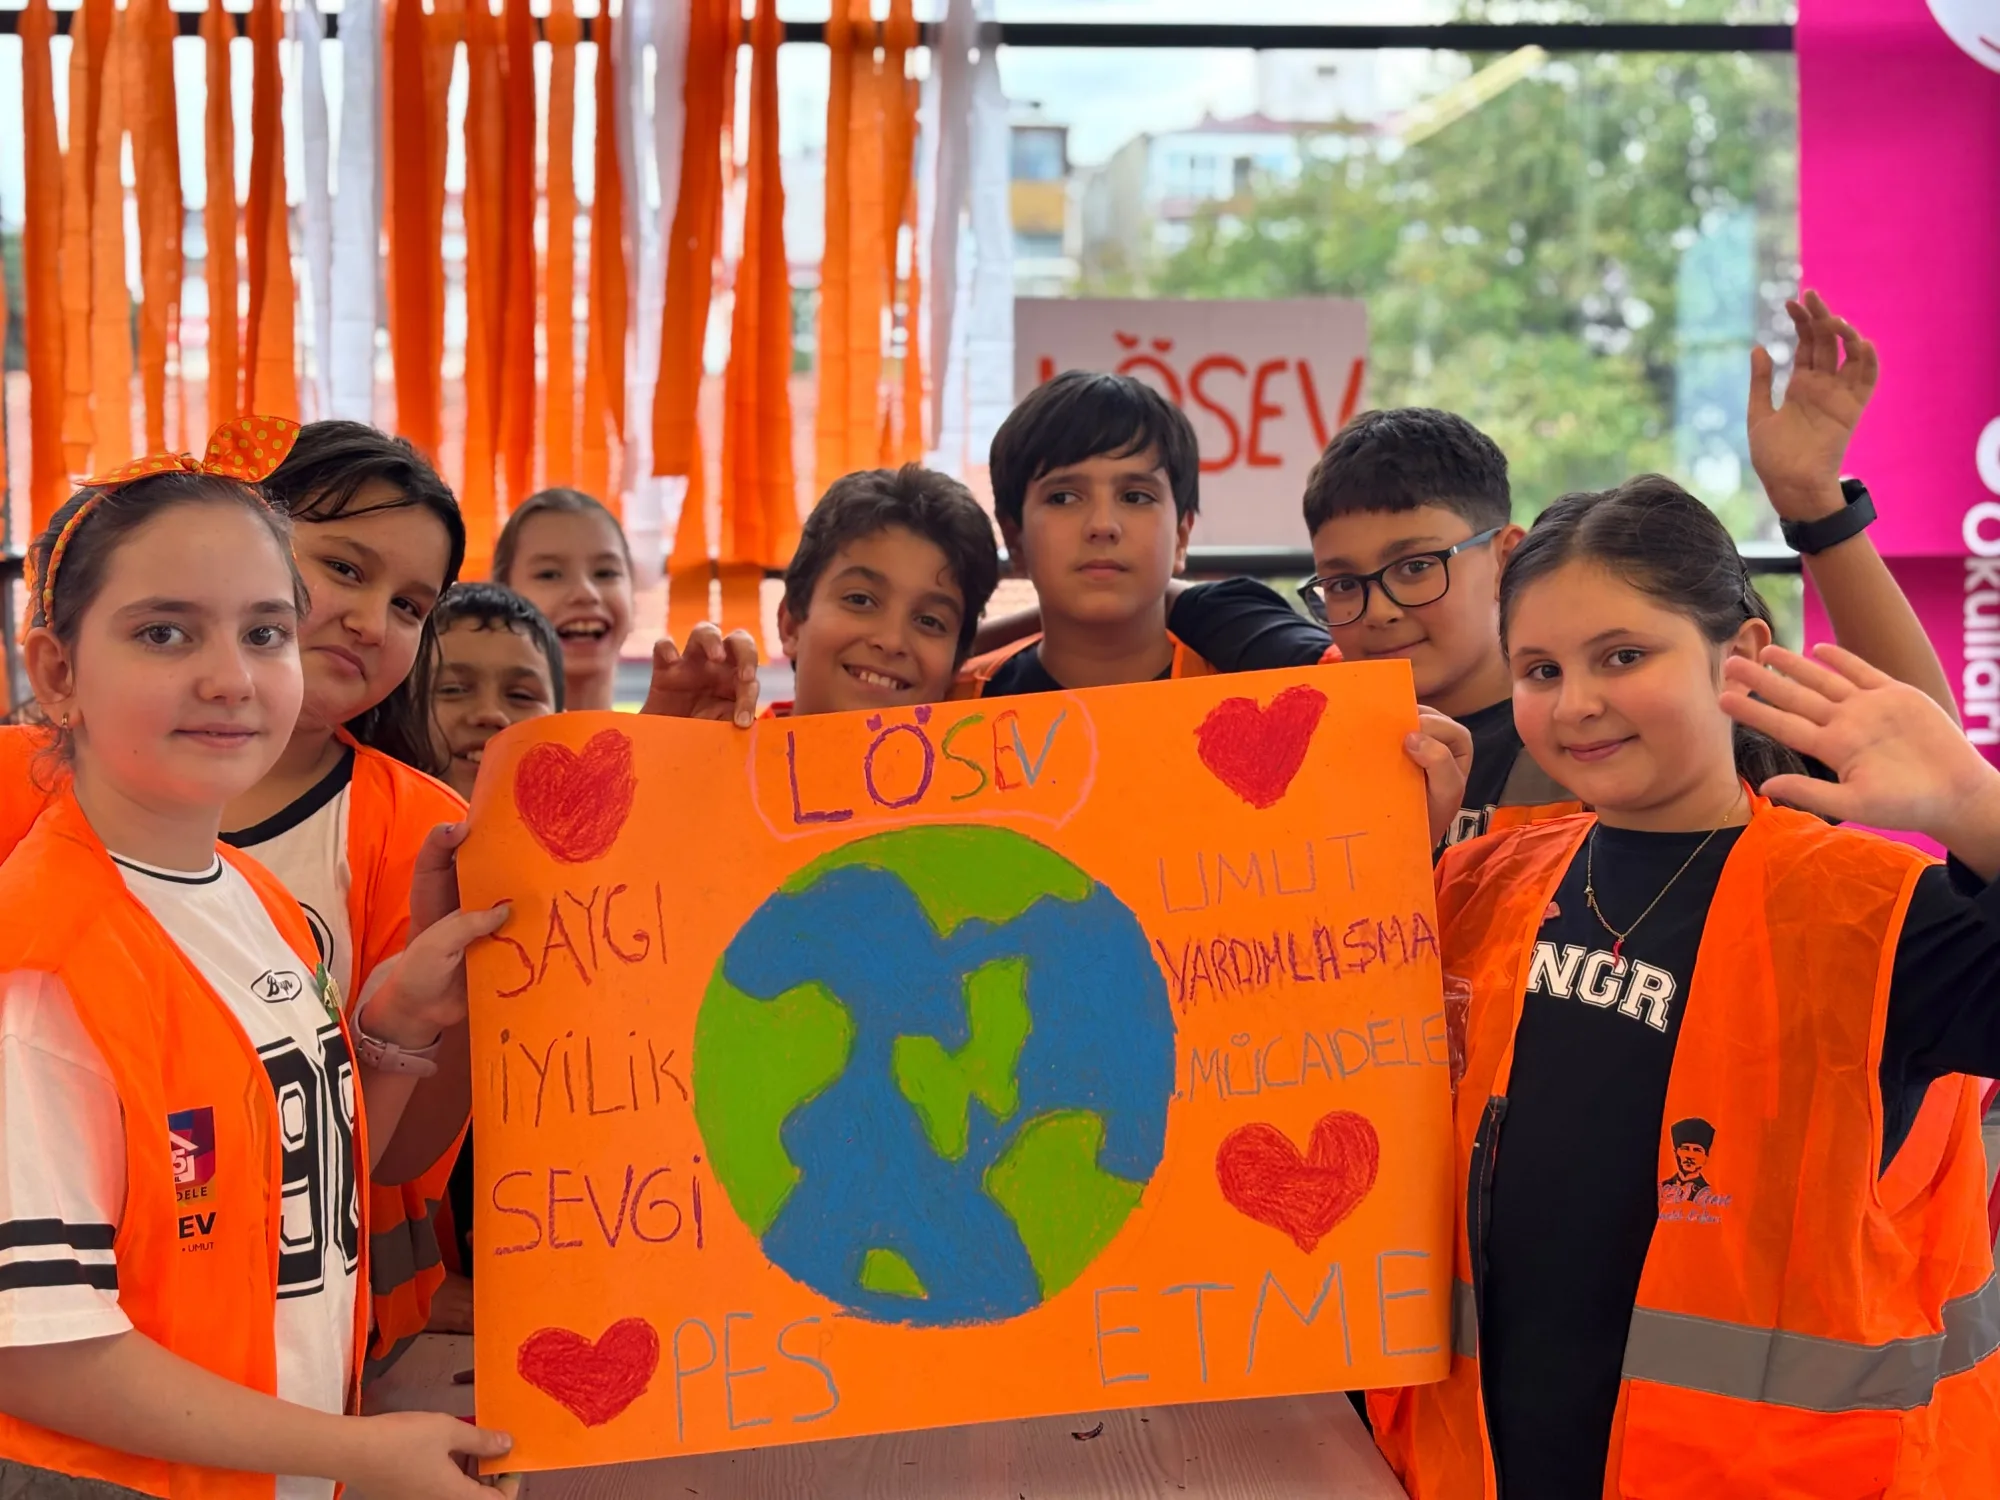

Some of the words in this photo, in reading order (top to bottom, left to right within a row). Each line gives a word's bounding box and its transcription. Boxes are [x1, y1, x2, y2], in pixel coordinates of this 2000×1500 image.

[786, 705, 1067, 825] LÖSEV
[1157, 831, 1369, 914] UMUT
[490, 880, 668, 998] SAYGI
[492, 1154, 704, 1255] SEVGİ
[673, 1312, 840, 1442] PES
[1095, 1250, 1440, 1387] ETME
